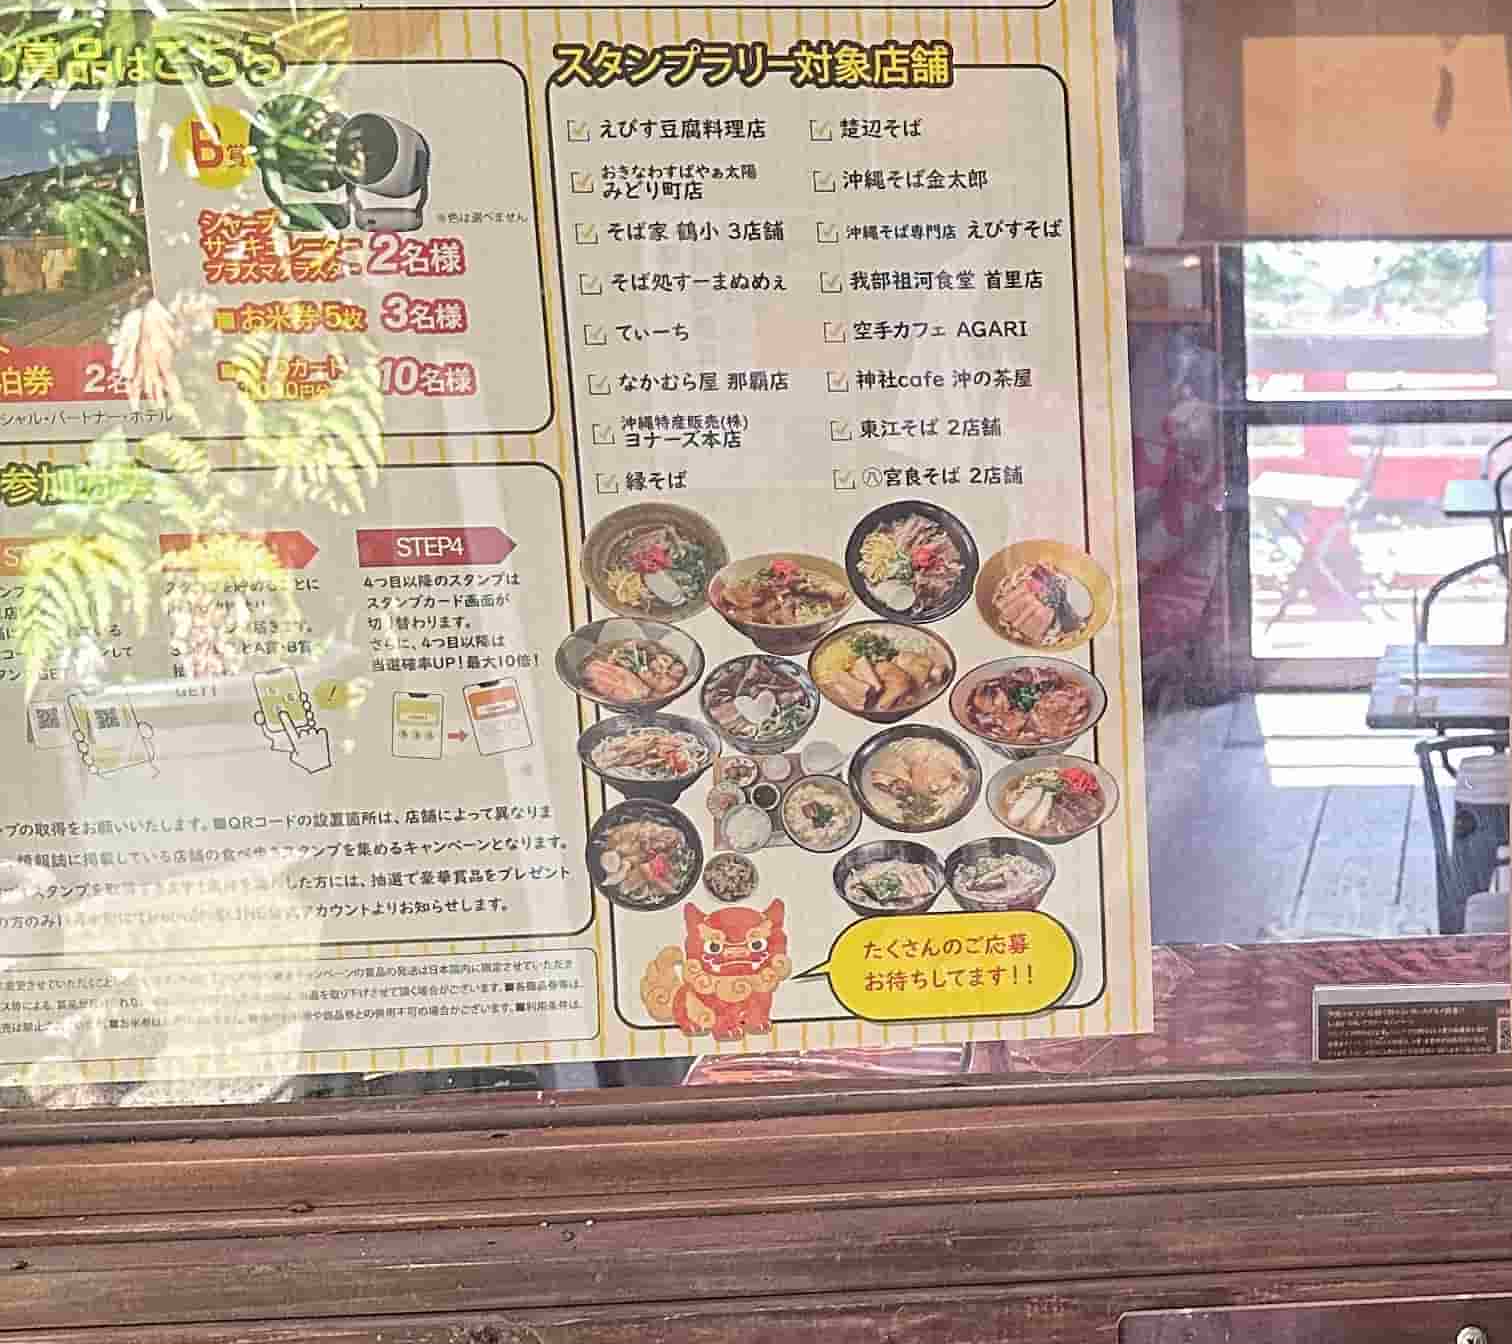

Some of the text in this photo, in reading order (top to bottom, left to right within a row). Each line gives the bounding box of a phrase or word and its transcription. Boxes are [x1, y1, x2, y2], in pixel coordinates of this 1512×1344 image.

[552, 39, 953, 88] スタンプラリー対象店舗
[599, 118, 767, 141] えびす豆腐料理店
[602, 181, 704, 201] みどり町店
[843, 168, 989, 191] 沖縄そば金太郎
[607, 220, 674, 243] そば家
[728, 219, 785, 243] 3店舗
[845, 217, 1063, 242] 沖縄そば専門店 えびすそば
[366, 230, 466, 276] 2名様
[610, 270, 788, 293] そば処すーまぬめぇ
[849, 269, 1044, 292] 我部祖河食堂 首里店
[381, 292, 468, 334] 3名様
[615, 323, 691, 343] てぃーち
[853, 319, 1030, 341] 空手カフェ AGARI
[380, 356, 478, 397] 10名様
[617, 370, 790, 392] なかむら屋 那覇店
[855, 369, 1033, 390] 神社cafe 沖の茶屋
[620, 413, 749, 433] 沖縄特産販売(株)
[859, 416, 1003, 440] 東江そば 2店舗
[623, 430, 743, 450] ヨナーズ本店
[625, 469, 688, 492] 縁そば
[968, 465, 1025, 486] 2店舗
[396, 536, 465, 557] STEP4
[362, 573, 521, 590] 4つ目以降のスタンプは
[862, 933, 1031, 962] たくさんのご応募
[863, 962, 1035, 992] お待ちしてます!!
